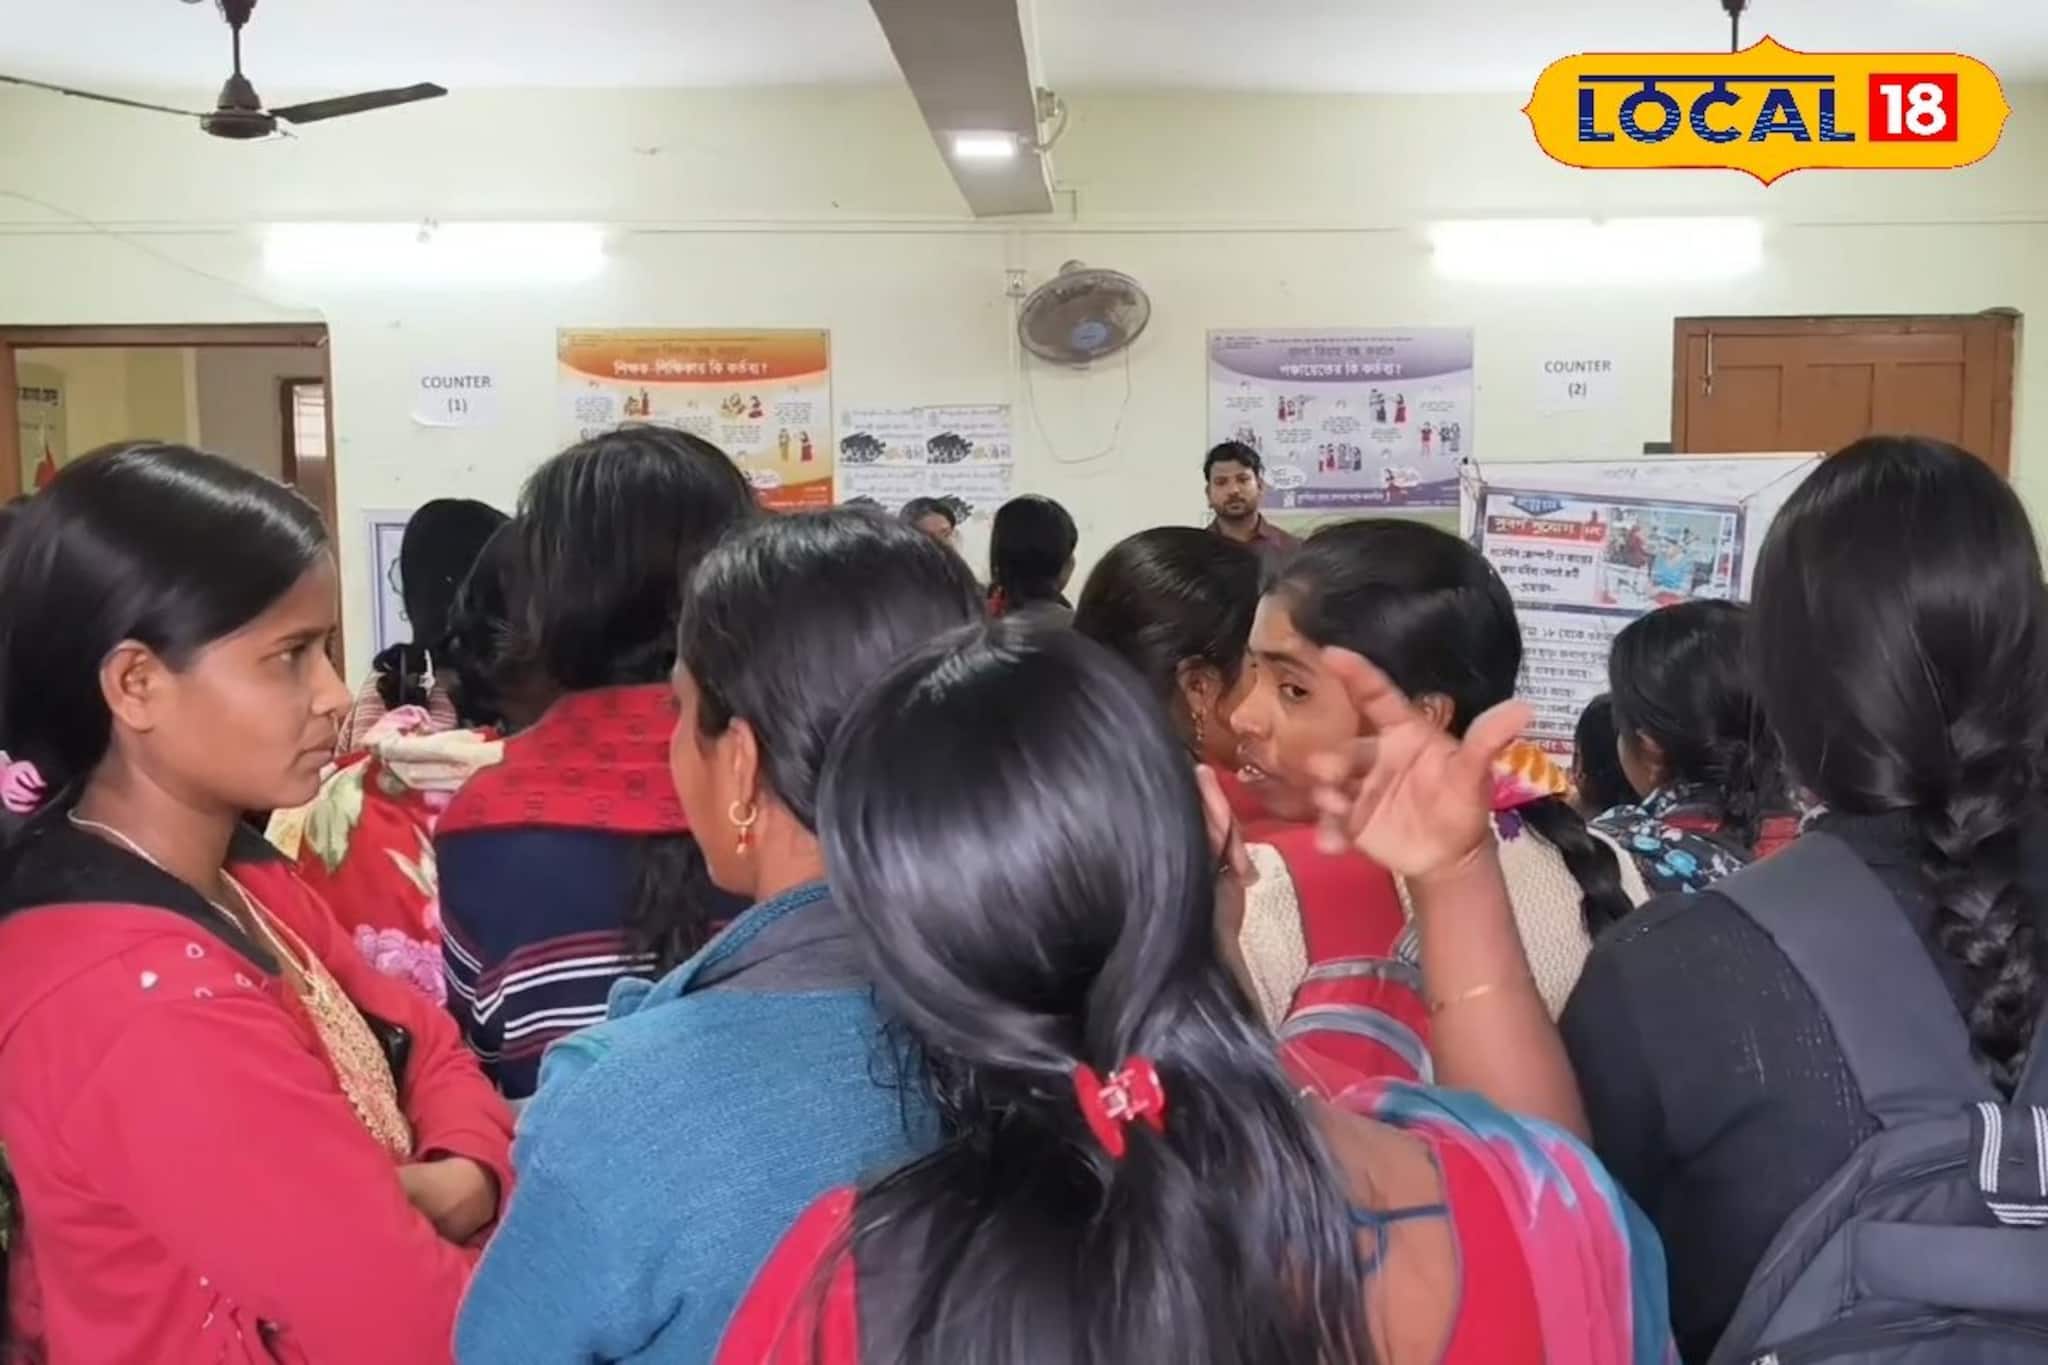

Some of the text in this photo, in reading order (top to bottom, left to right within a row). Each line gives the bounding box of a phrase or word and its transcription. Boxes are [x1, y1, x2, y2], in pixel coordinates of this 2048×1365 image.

[1543, 359, 1612, 373] COUNTER
[421, 375, 491, 389] COUNTER
[1567, 381, 1587, 399] (2)
[448, 397, 468, 414] (1)
